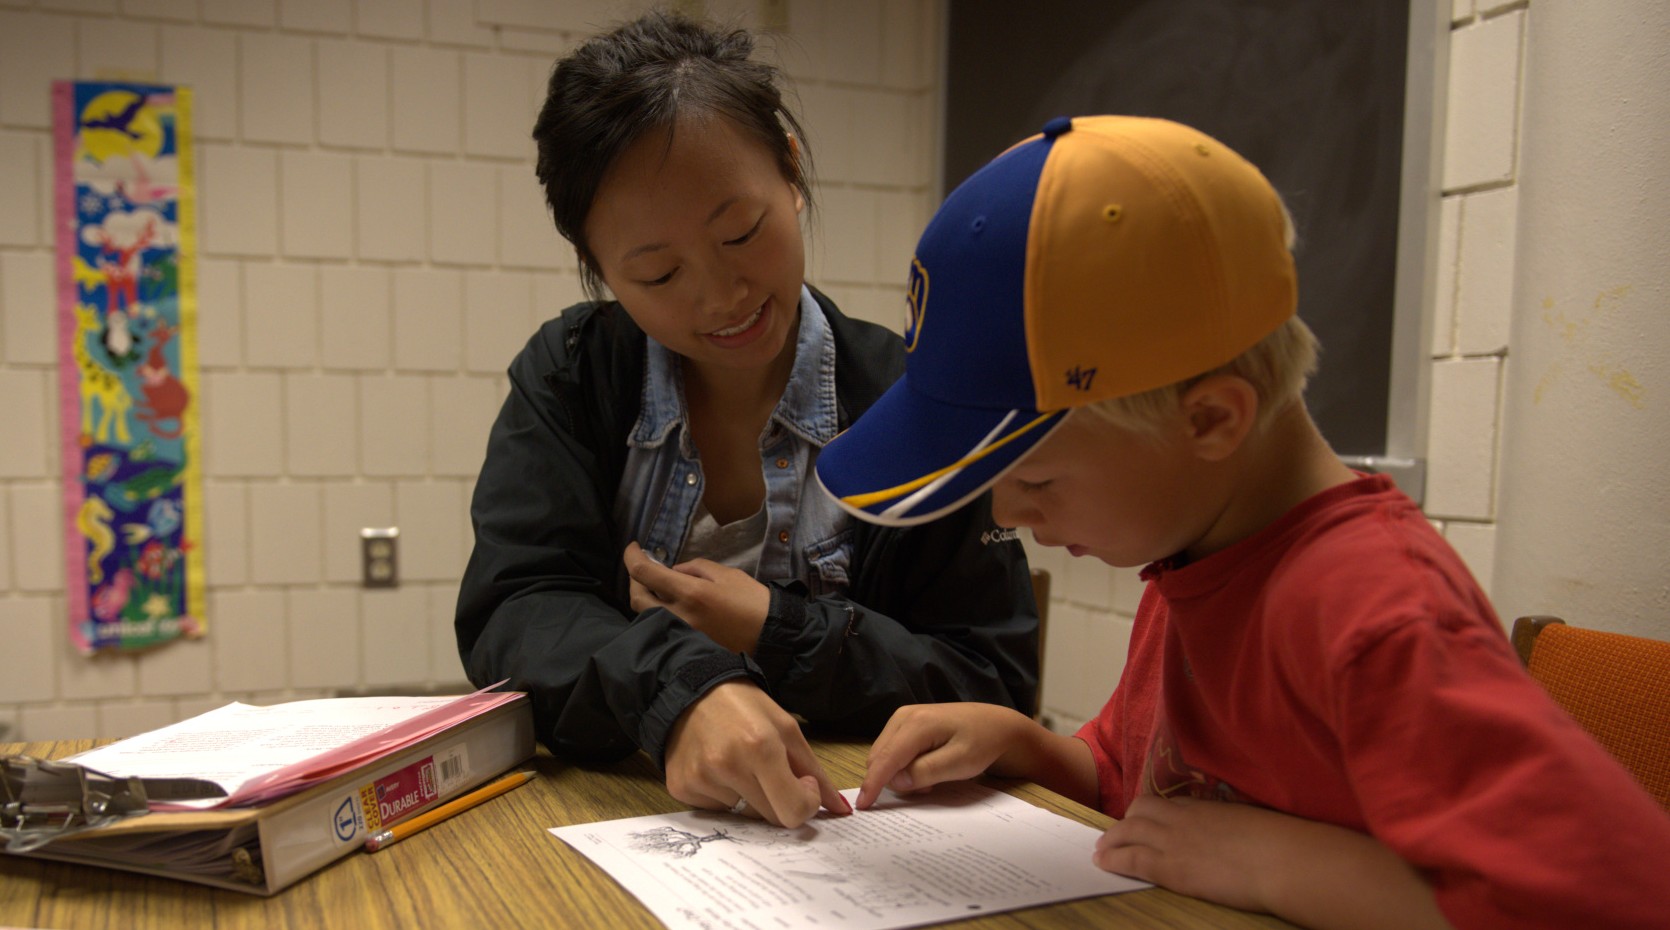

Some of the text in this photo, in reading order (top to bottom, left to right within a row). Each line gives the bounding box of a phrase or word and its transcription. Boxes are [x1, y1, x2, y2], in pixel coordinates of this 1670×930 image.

[361, 790, 374, 829] CLEAR
[367, 787, 380, 827] COVER
[379, 790, 420, 820] DURABLE
